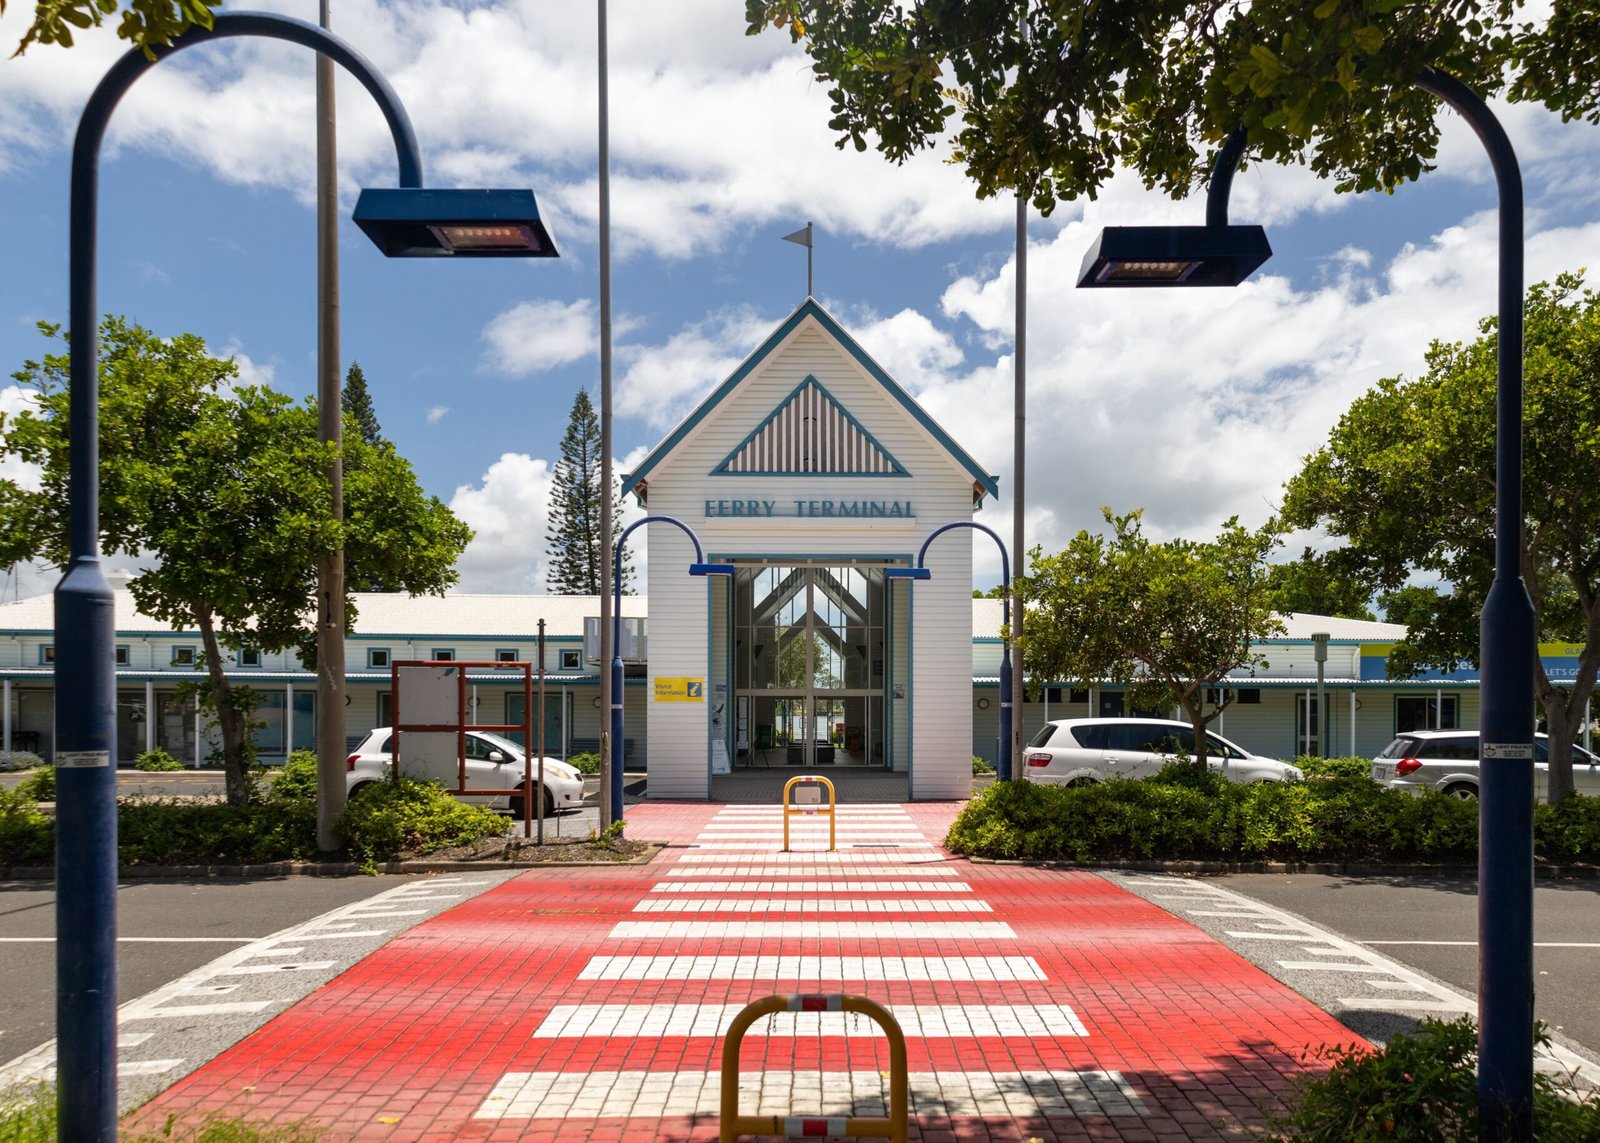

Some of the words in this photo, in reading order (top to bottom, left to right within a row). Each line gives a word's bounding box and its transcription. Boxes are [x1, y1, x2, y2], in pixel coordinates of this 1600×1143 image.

[704, 500, 776, 517] FERRY
[793, 500, 916, 518] TERMINAL
[1545, 668, 1567, 676] LET'S
